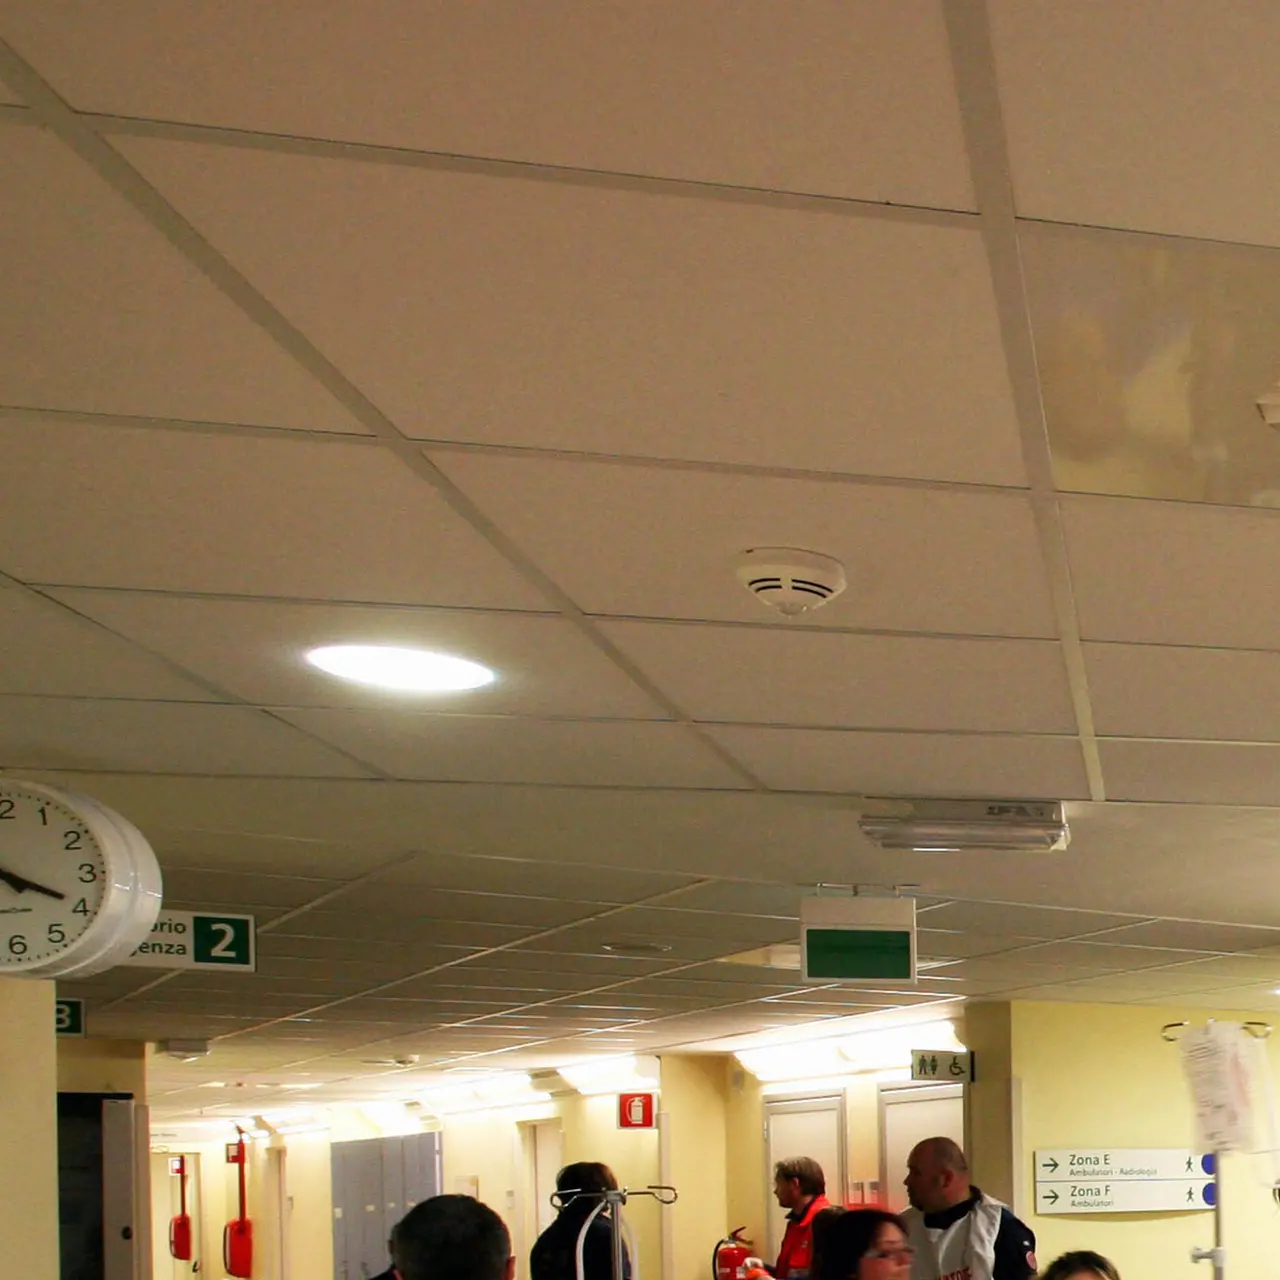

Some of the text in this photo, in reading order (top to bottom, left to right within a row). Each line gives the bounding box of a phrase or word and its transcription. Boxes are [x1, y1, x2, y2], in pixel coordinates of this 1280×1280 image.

[0, 800, 15, 820] 2
[38, 806, 47, 826] 1
[64, 830, 82, 850] 2
[78, 863, 97, 883] 3
[72, 898, 90, 916] 4
[47, 924, 65, 943] 5
[210, 923, 236, 957] 2
[8, 935, 27, 955] 6
[129, 941, 187, 958] enza
[1069, 1154, 1111, 1166] Zona E
[1070, 1185, 1111, 1197] Zona F
